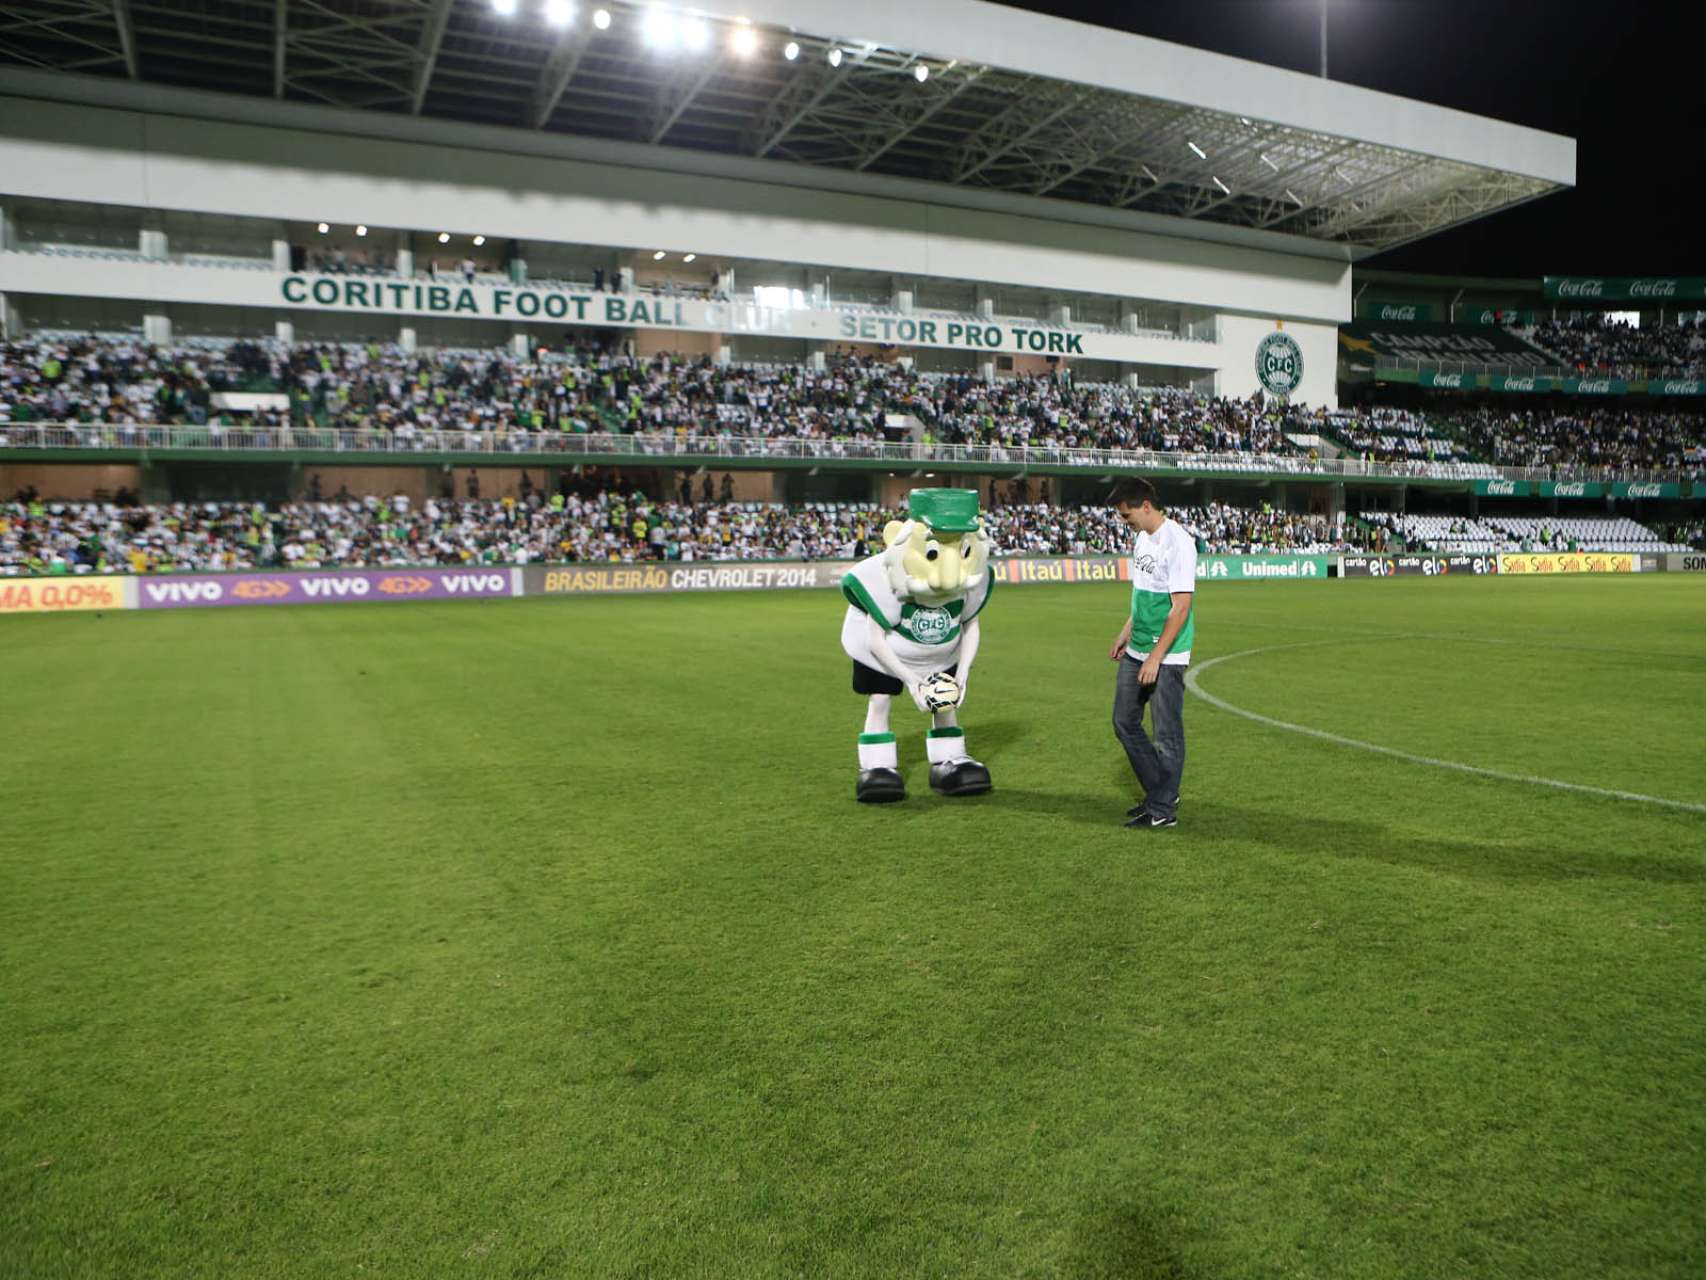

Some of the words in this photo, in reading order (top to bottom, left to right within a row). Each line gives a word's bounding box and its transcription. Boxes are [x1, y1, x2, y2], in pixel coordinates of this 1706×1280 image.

[281, 276, 479, 314] CORITIBA
[493, 290, 592, 320] FOOT
[606, 298, 691, 327] BALL
[840, 315, 938, 344] SETOR
[947, 324, 1001, 347] PRO
[1012, 328, 1083, 354] TORK
[544, 566, 668, 592] BRASILEIRÃO
[671, 568, 778, 588] CHEVROLET
[778, 568, 816, 588] 2014
[1021, 560, 1062, 581] Itaú
[1077, 560, 1116, 580] Itaú
[1242, 561, 1297, 577] Unimed
